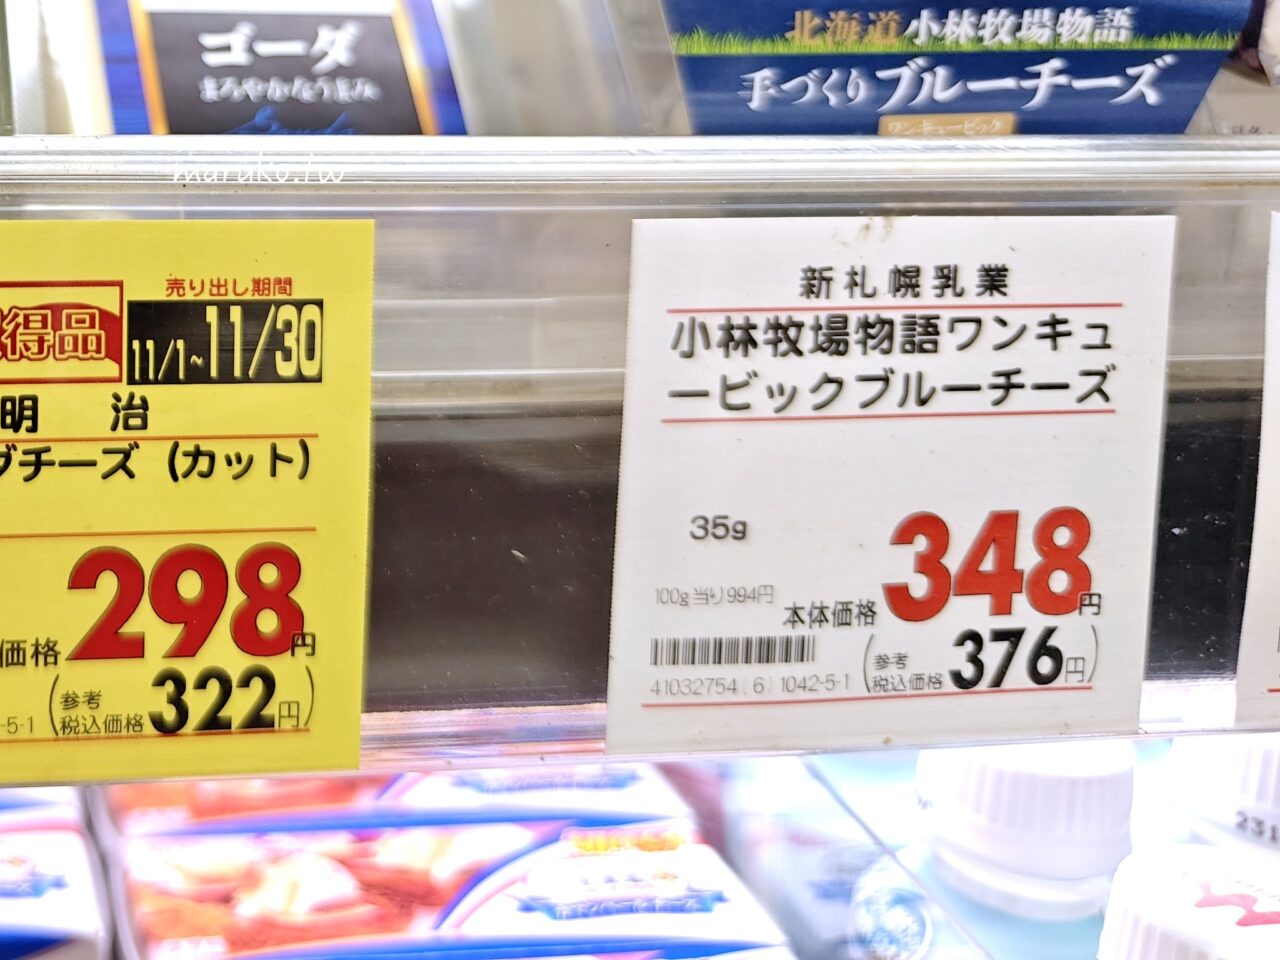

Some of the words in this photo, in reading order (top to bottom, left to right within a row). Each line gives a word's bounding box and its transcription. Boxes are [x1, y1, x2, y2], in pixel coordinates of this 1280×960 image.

[198, 21, 363, 74] ゴーダ
[164, 277, 293, 298] 売り出し期間
[799, 263, 1011, 300] 新札幌乳業
[671, 311, 1113, 359] 小林牧場物語ワンキュ
[667, 364, 1116, 414] ービックブルーチーズ
[689, 514, 748, 542] 35g
[782, 598, 878, 629] 本体価格
[873, 651, 909, 672] 参考
[650, 677, 738, 696] 41032754
[781, 674, 850, 695] 1042-5-1
[871, 671, 944, 694] 税込価格
[59, 689, 103, 711] 参考
[58, 712, 145, 737] 税込価格
